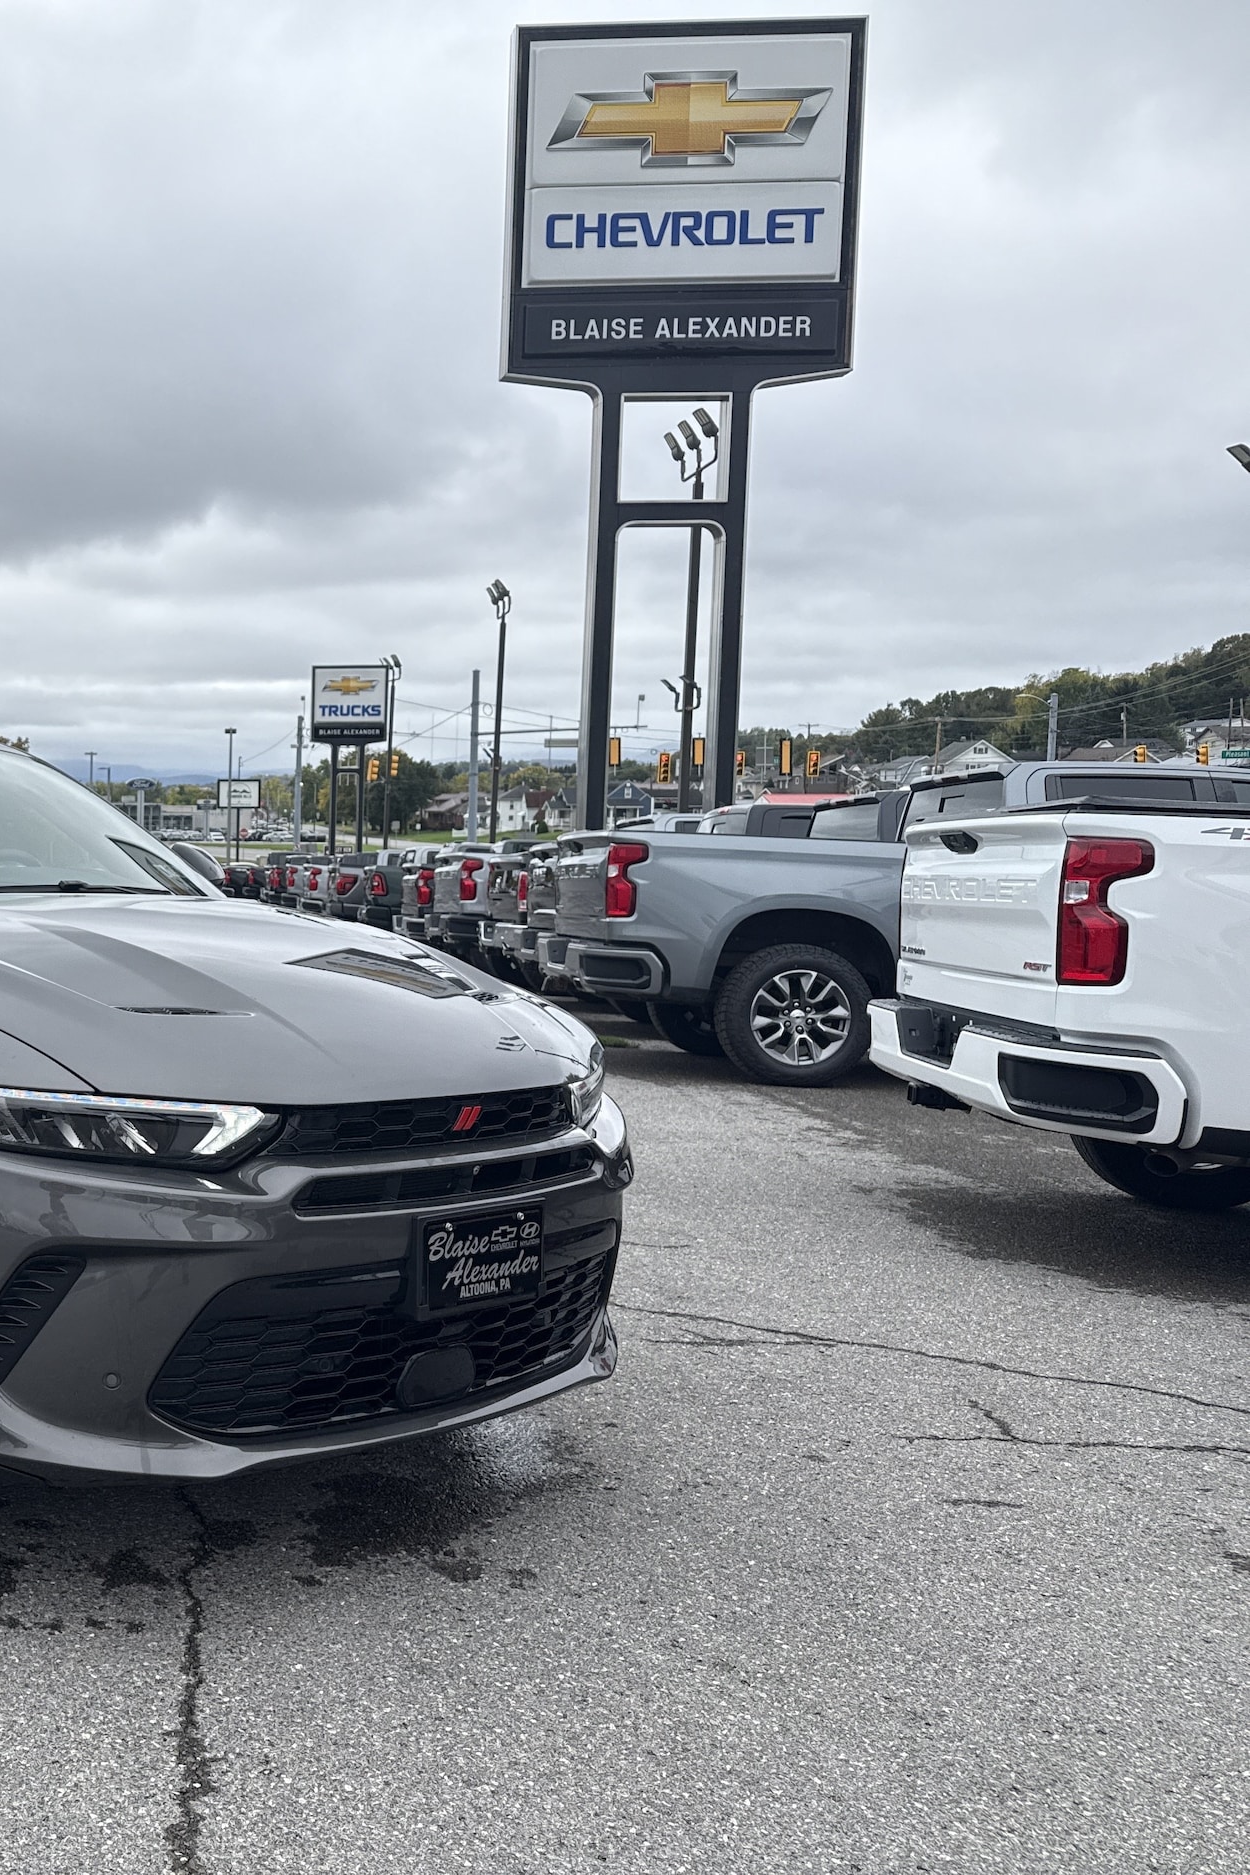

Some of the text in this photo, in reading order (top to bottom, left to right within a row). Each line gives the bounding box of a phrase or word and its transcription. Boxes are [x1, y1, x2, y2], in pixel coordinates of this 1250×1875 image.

[546, 208, 825, 249] CHEVROLET
[551, 316, 812, 340] BLAISE ALEXANDER
[319, 705, 381, 717] TRUCKS
[902, 877, 1037, 903] CHEVROLET
[1023, 961, 1052, 973] RST
[428, 1231, 490, 1262] Blaise
[442, 1249, 539, 1290] Alexander
[459, 1277, 511, 1298] ALTOONA, PA
